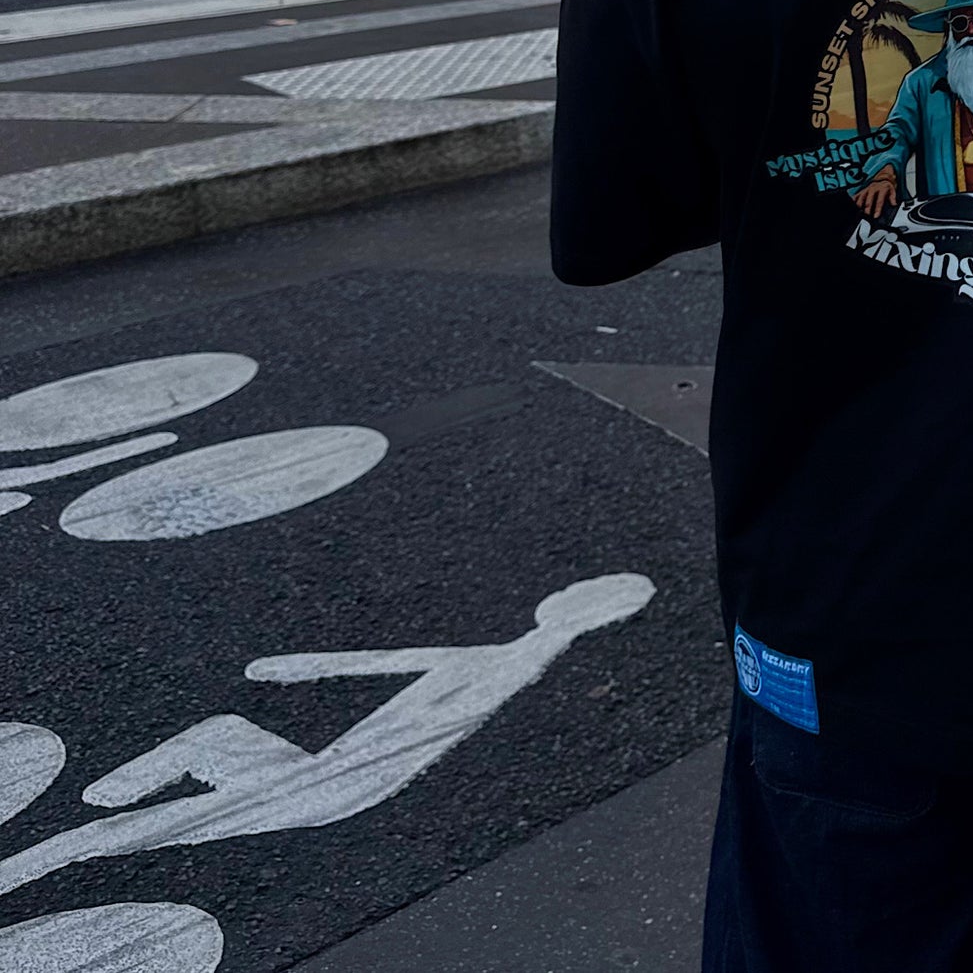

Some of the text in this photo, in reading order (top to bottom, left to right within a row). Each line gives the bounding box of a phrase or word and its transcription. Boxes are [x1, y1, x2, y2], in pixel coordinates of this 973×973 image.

[812, 19, 854, 129] SUNSET
[766, 131, 893, 178] Mystique
[814, 167, 863, 192] Isle
